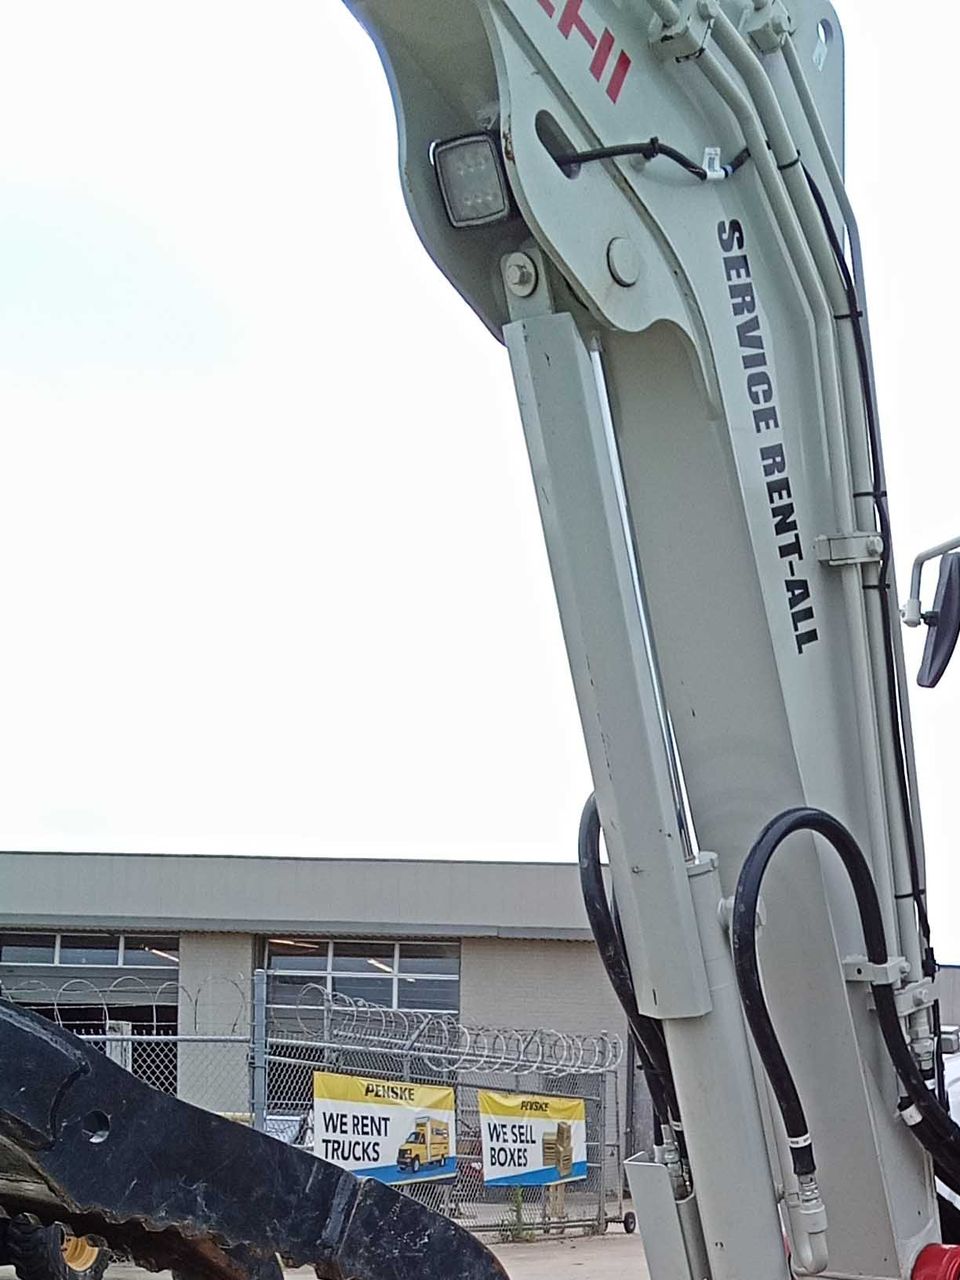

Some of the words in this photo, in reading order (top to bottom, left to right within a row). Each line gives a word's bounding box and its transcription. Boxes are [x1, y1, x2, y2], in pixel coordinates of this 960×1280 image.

[717, 218, 779, 434] SERVICE
[759, 443, 819, 655] RENT-ALL
[364, 1083, 415, 1101] PENSKE
[322, 1112, 348, 1134] WE
[352, 1115, 390, 1137] RENT
[488, 1122, 508, 1142] WE
[511, 1124, 536, 1144] SELL
[322, 1139, 380, 1162] TRUCKS
[490, 1147, 528, 1167] BOXES
